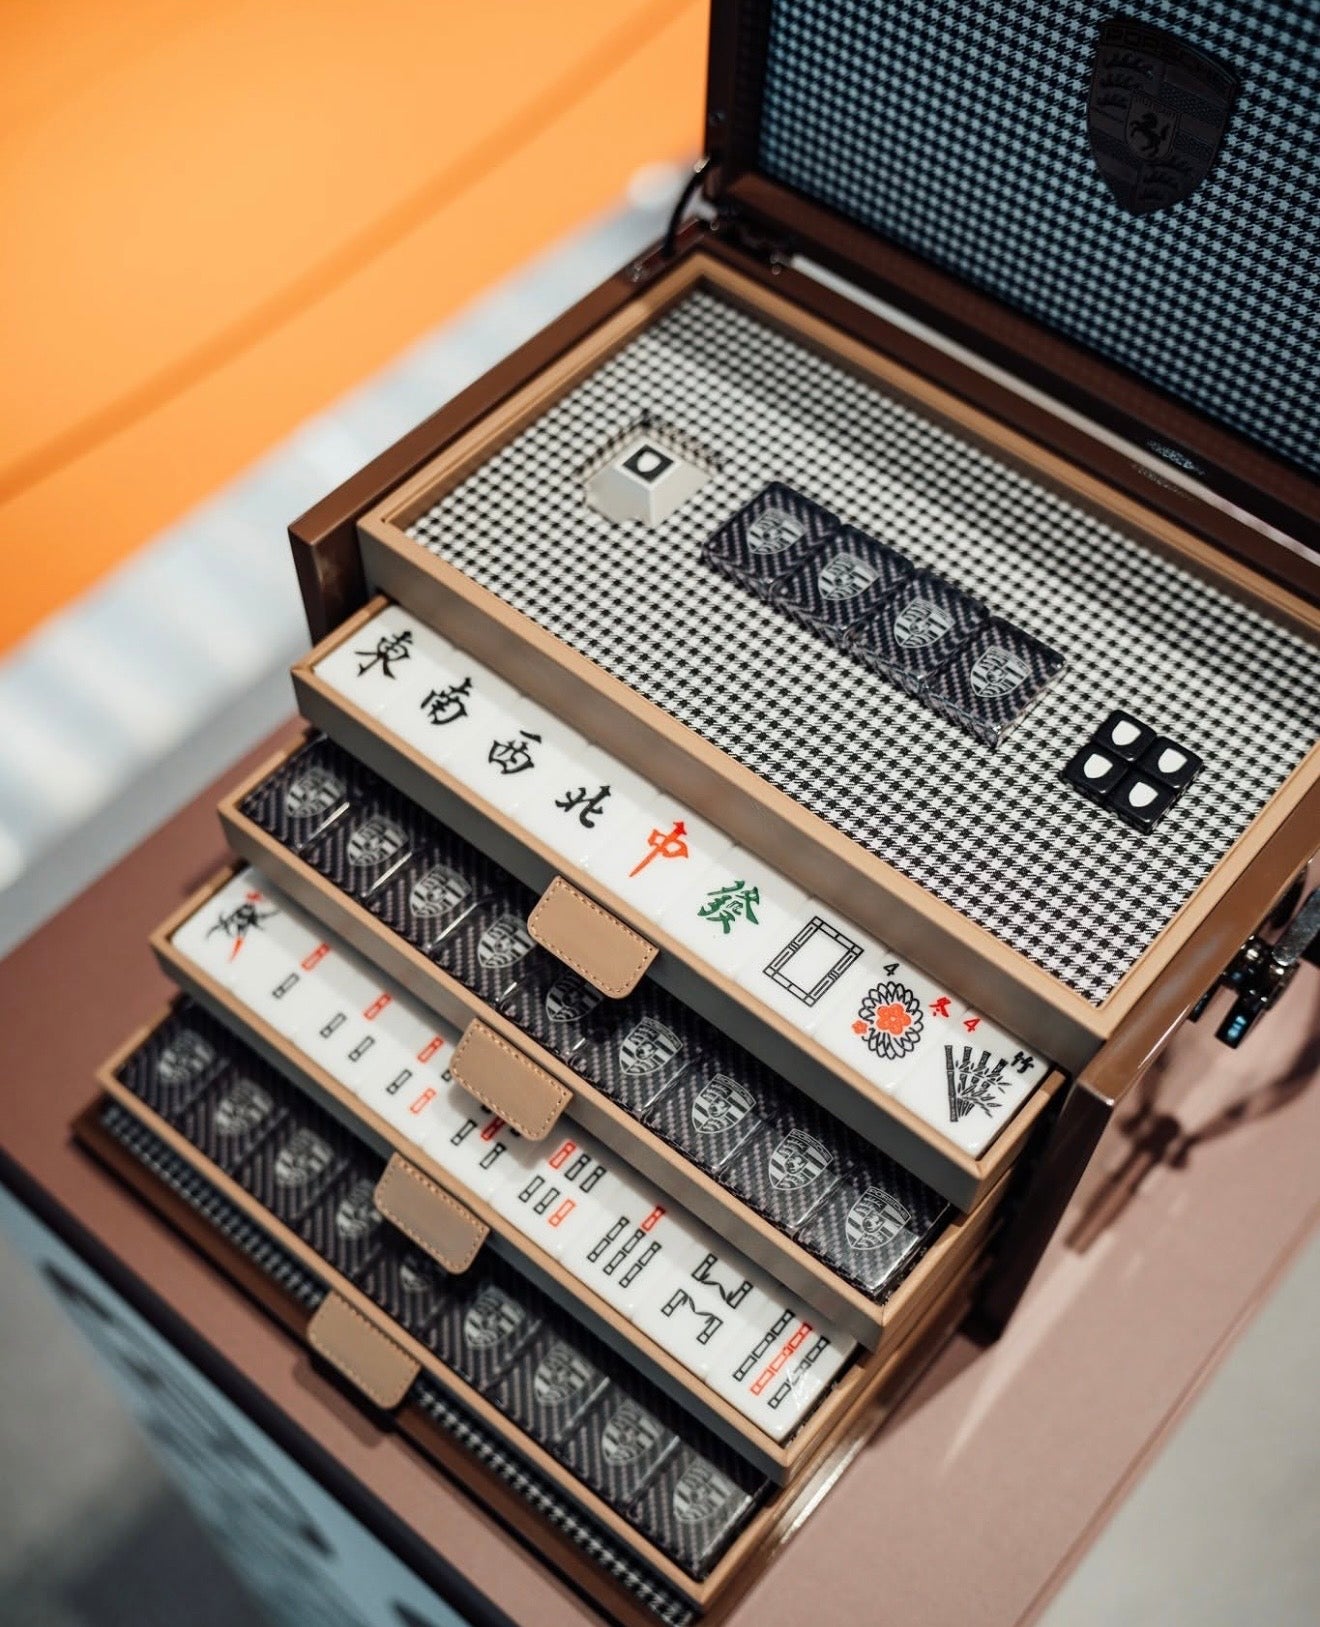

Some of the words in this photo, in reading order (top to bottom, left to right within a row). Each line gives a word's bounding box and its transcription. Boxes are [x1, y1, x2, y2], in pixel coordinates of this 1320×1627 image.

[354, 630, 413, 680] 東
[420, 677, 473, 726] 南
[488, 730, 542, 775] 西
[555, 785, 612, 829] 北
[629, 820, 690, 878] 中
[697, 880, 760, 935] 發
[883, 962, 900, 977] 4
[963, 1017, 982, 1033] 4
